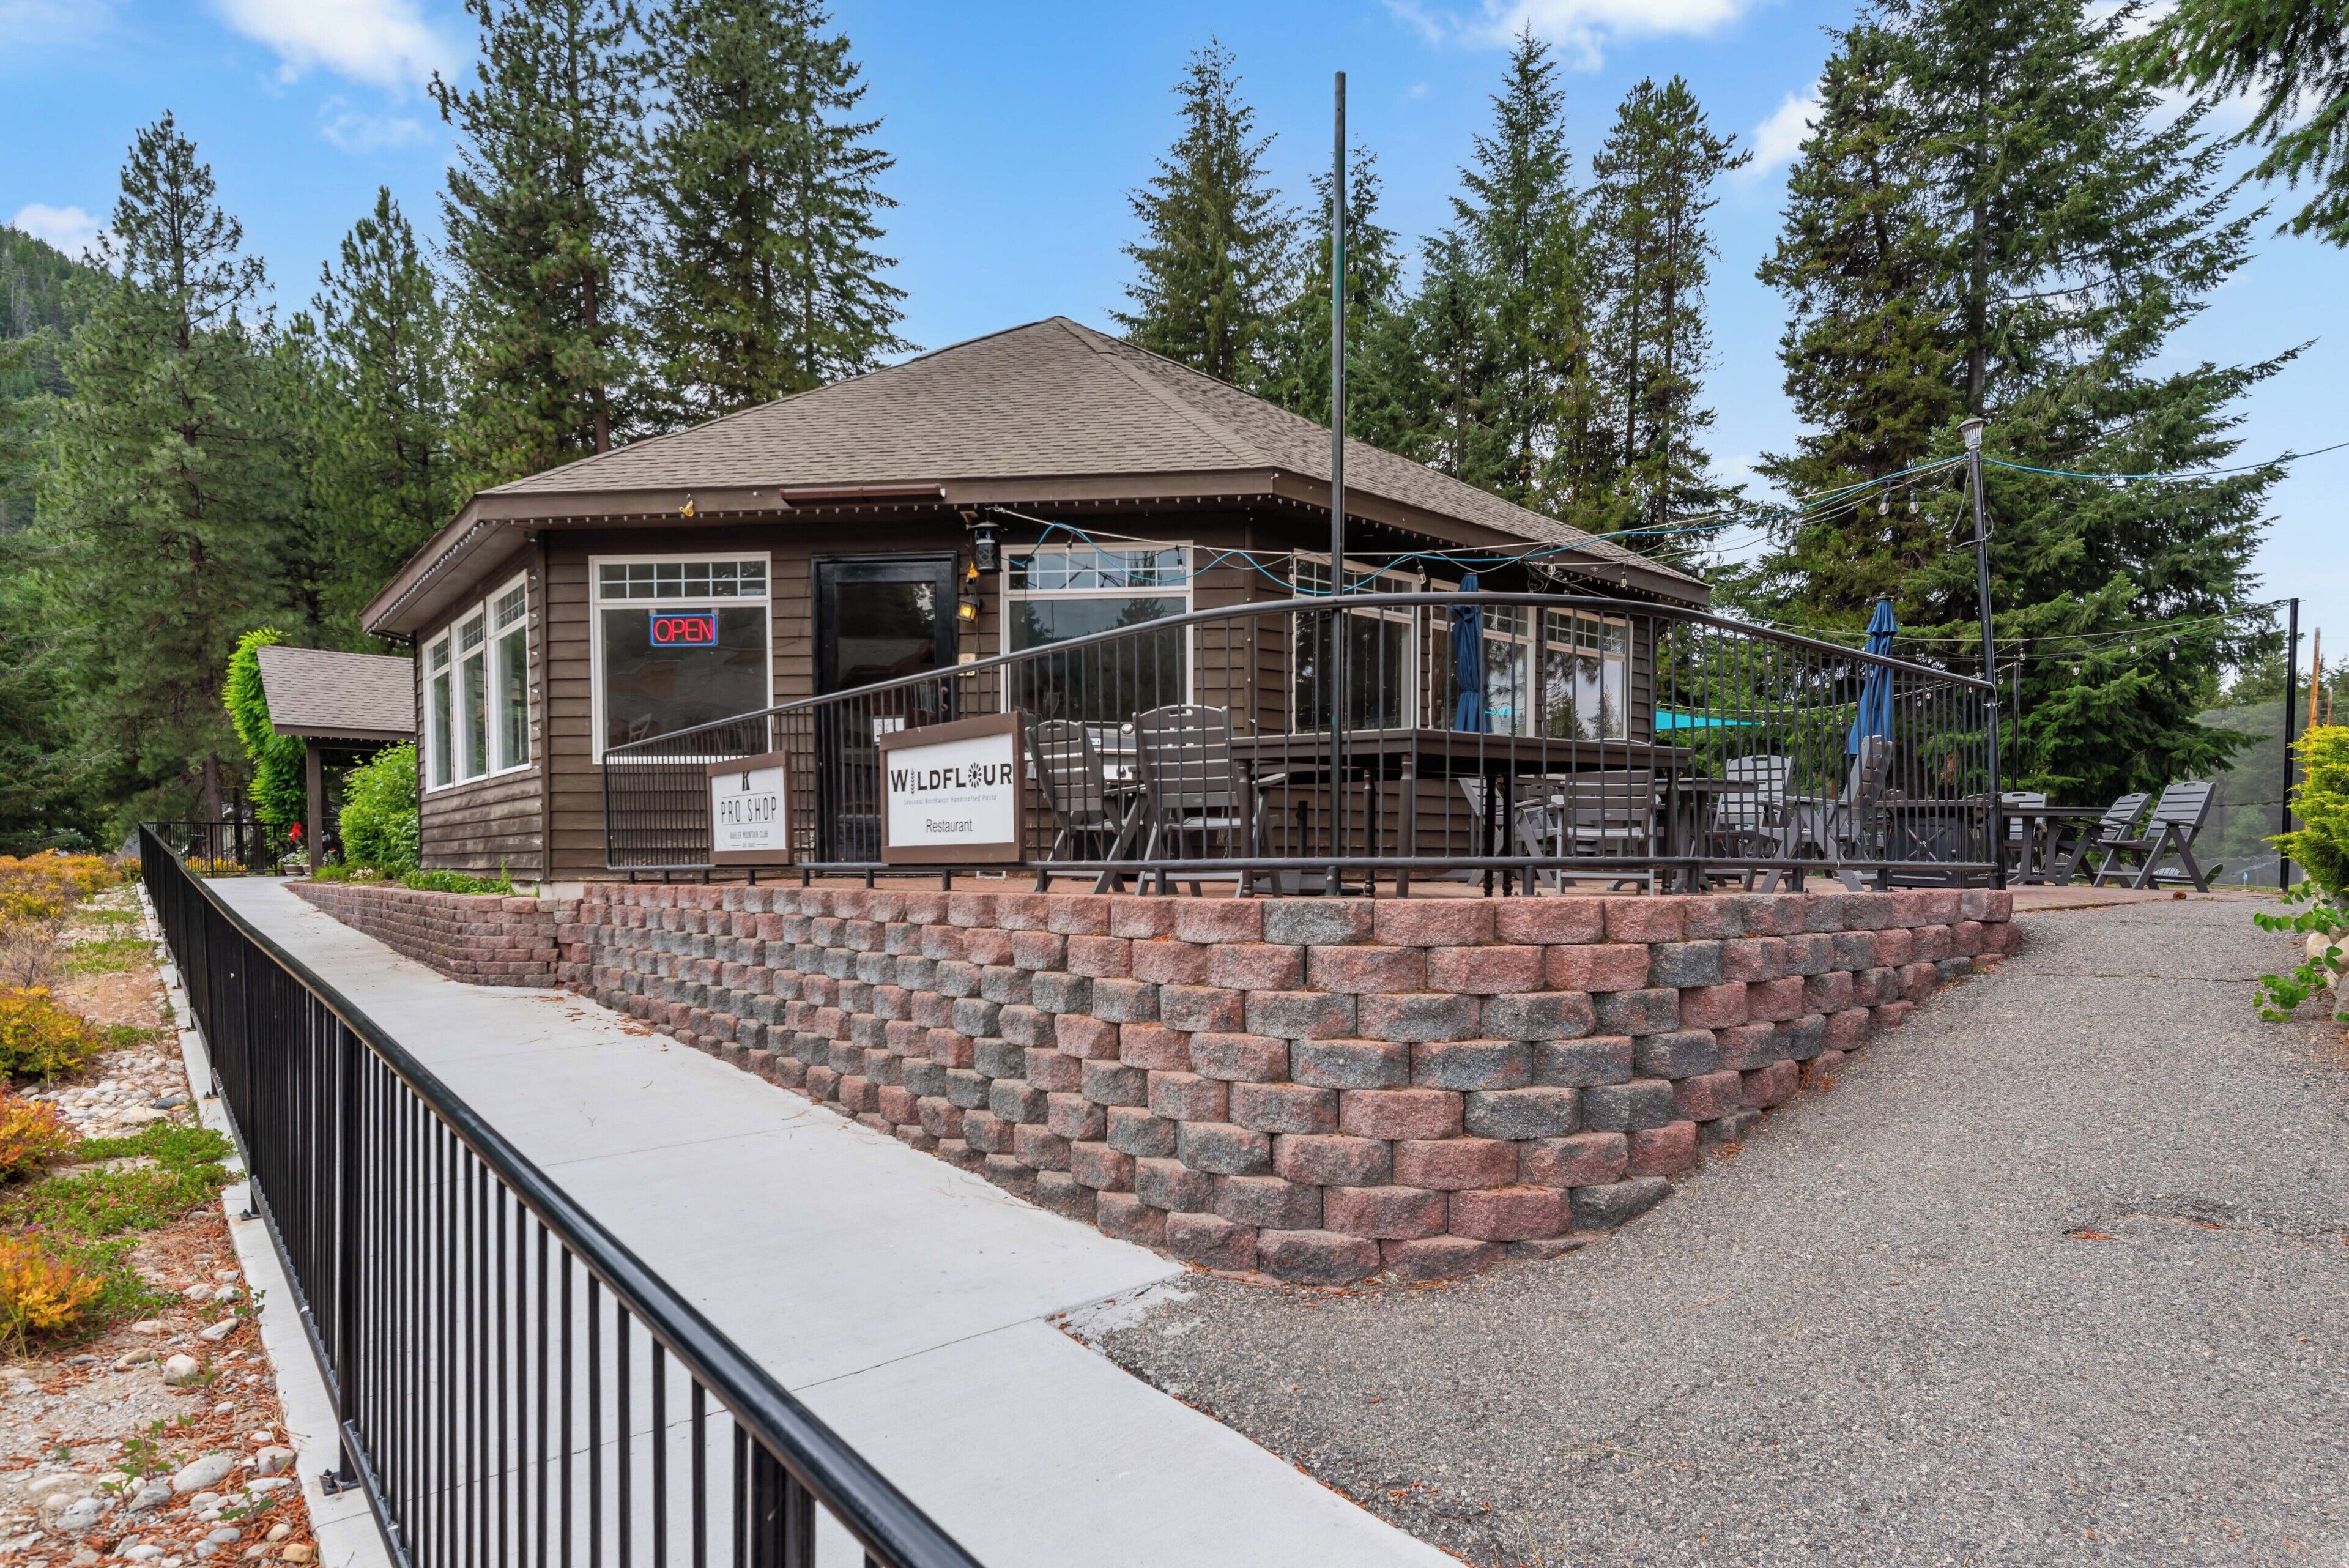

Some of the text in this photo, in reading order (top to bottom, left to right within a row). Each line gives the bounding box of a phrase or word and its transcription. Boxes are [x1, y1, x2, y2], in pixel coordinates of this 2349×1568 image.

[653, 618, 713, 642] OPEN
[721, 797, 776, 823] PRO SHOP
[926, 819, 973, 833] Restaurant
